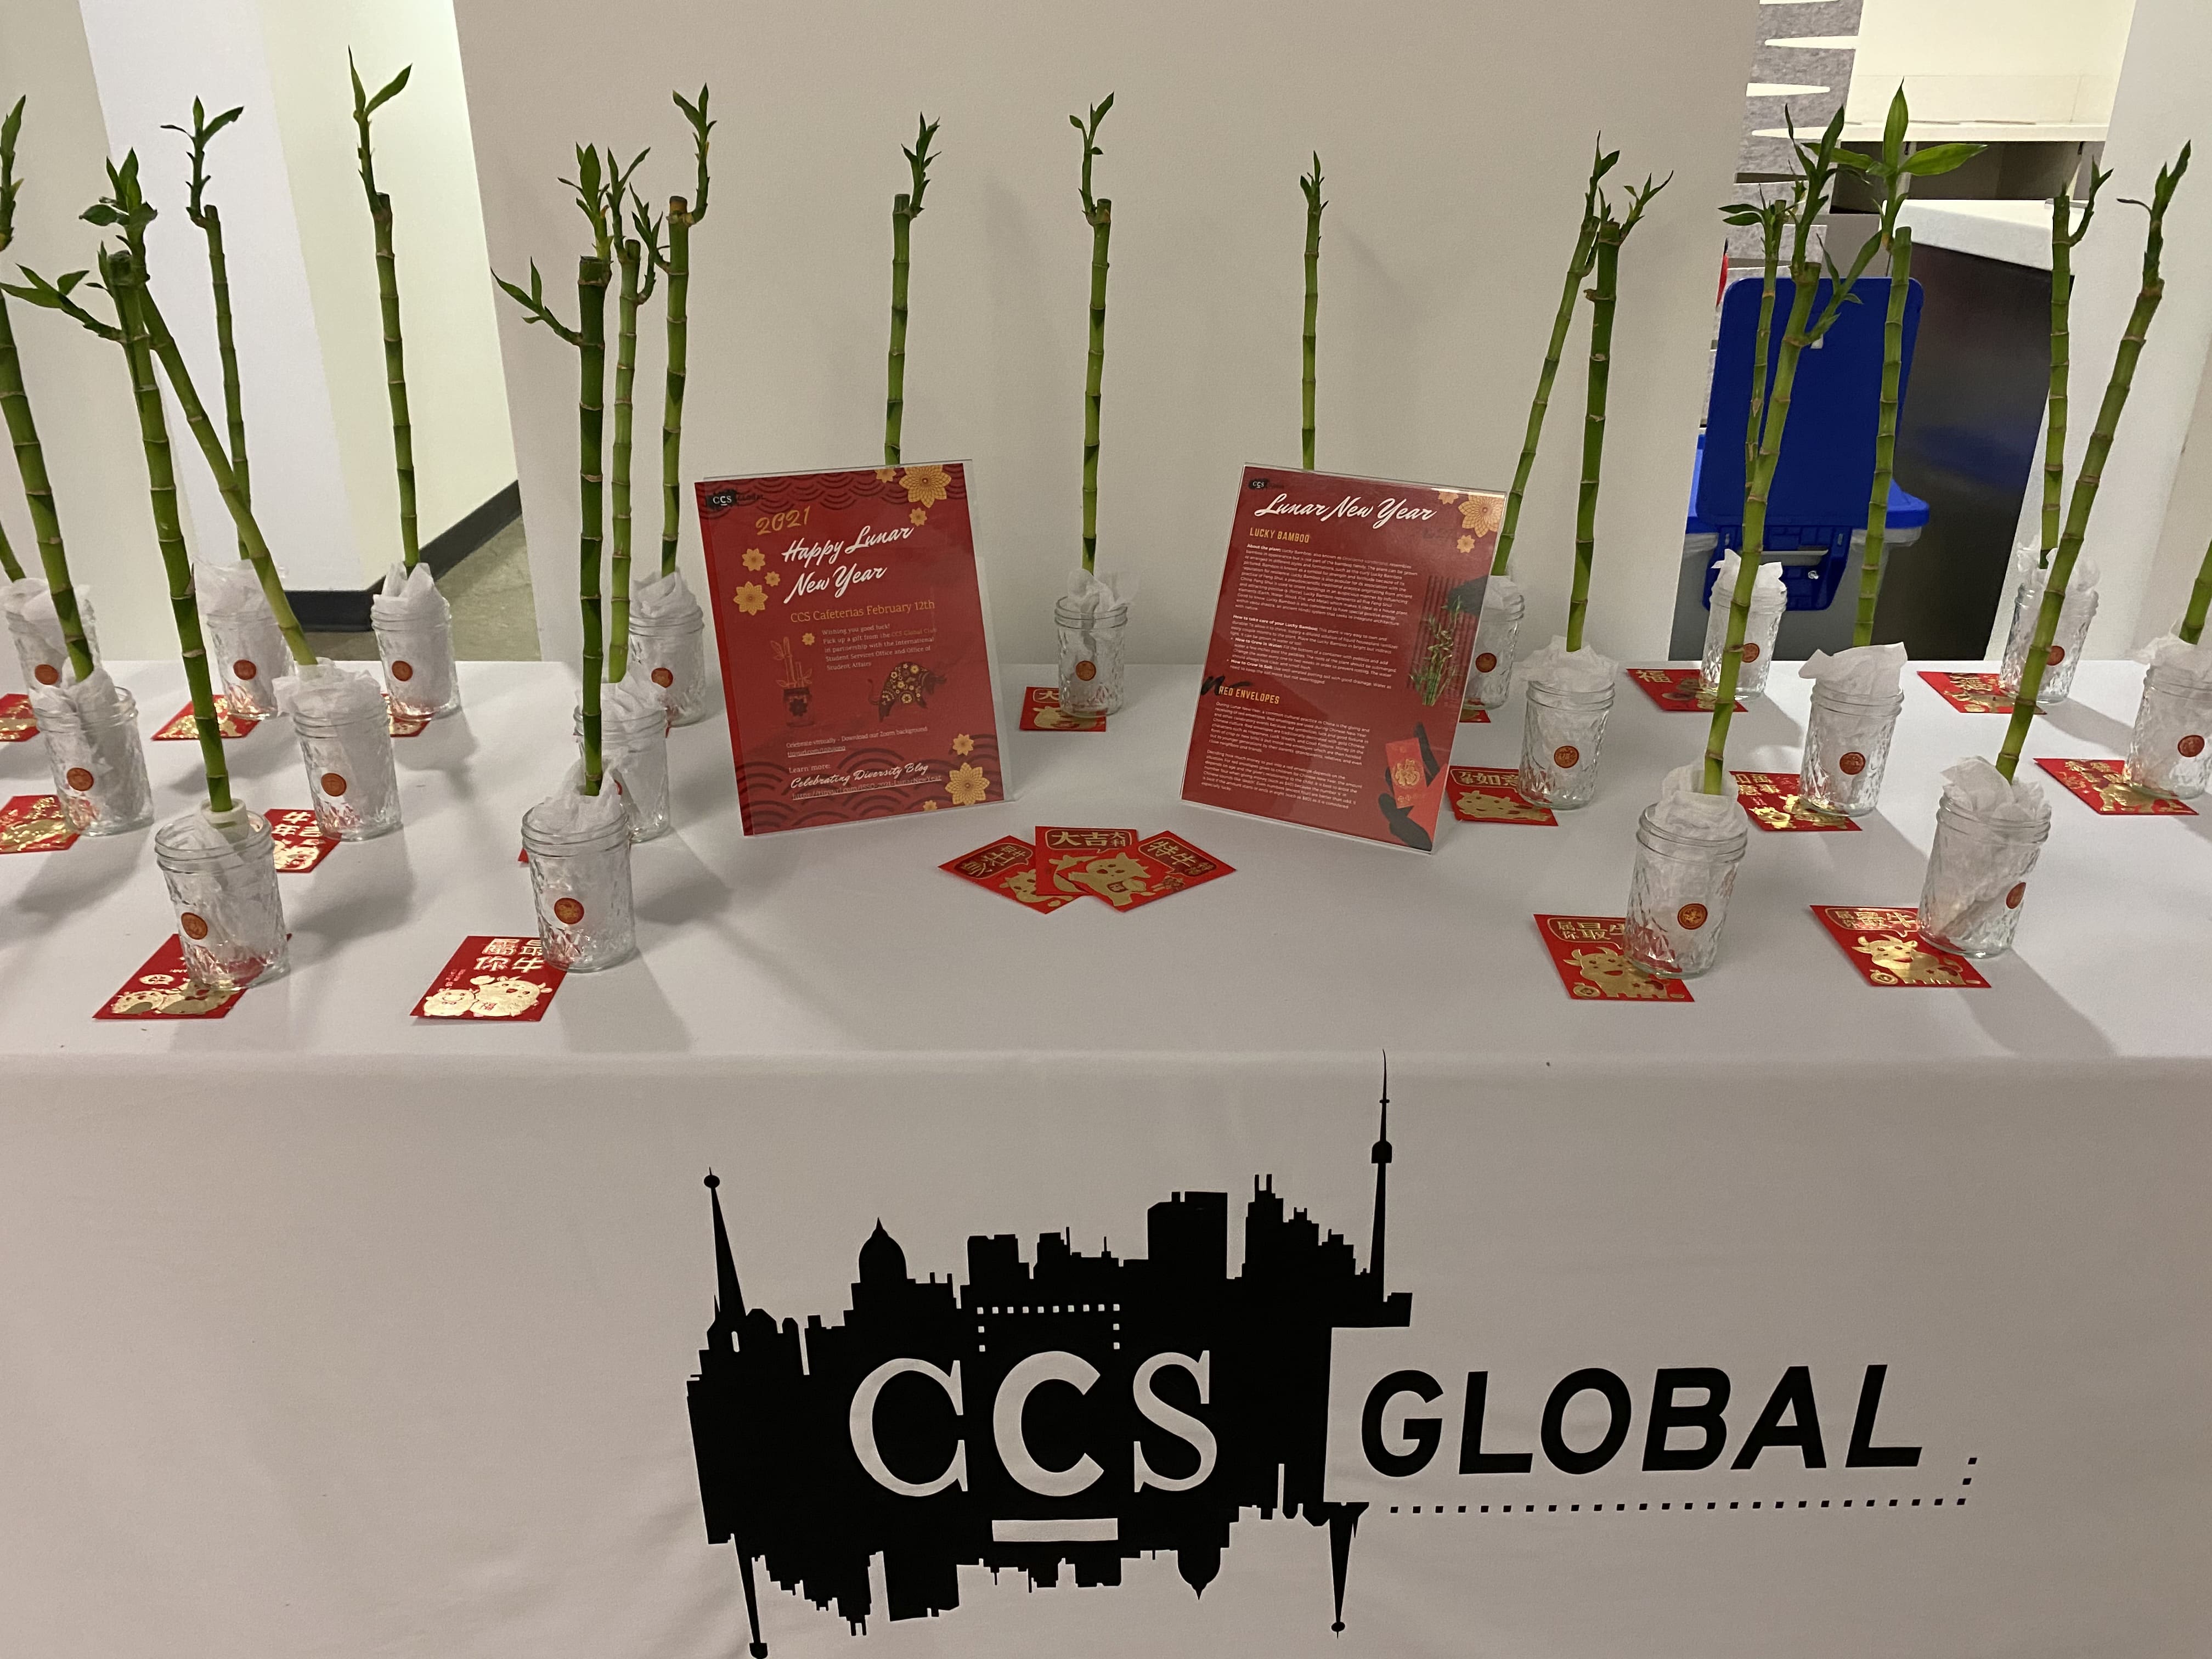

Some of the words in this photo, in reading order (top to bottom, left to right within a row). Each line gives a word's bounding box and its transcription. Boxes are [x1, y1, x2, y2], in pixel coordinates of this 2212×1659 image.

[713, 495, 732, 505] CCS
[1254, 493, 1330, 517] Lunar
[1321, 496, 1374, 522] New
[1372, 498, 1437, 529] Year
[755, 505, 811, 535] 2021
[781, 537, 844, 568] Happy
[844, 524, 915, 554] Lunar
[1249, 527, 1276, 539] LUCKY
[1277, 531, 1310, 543] BAMBOO
[783, 571, 830, 604] New
[832, 563, 888, 598] Year
[790, 612, 810, 623] CCS
[812, 606, 864, 620] Cafeterias
[866, 602, 912, 618] February
[913, 600, 935, 611] 12th
[821, 628, 847, 636] Wishing
[832, 644, 867, 653] partnership
[1635, 670, 1673, 684] 福
[1218, 686, 1233, 696] RED
[1235, 688, 1280, 704] ENVELOPES
[786, 740, 812, 748] Celebrate
[841, 733, 869, 742] Download
[896, 726, 928, 736] background
[790, 774, 850, 789] Celebrating
[853, 766, 902, 781] Diversity
[904, 762, 929, 776] Blog
[1051, 831, 1126, 847] 大吉大利
[849, 1350, 1218, 1497] CCS
[1361, 1364, 1923, 1477] GLOBAL
